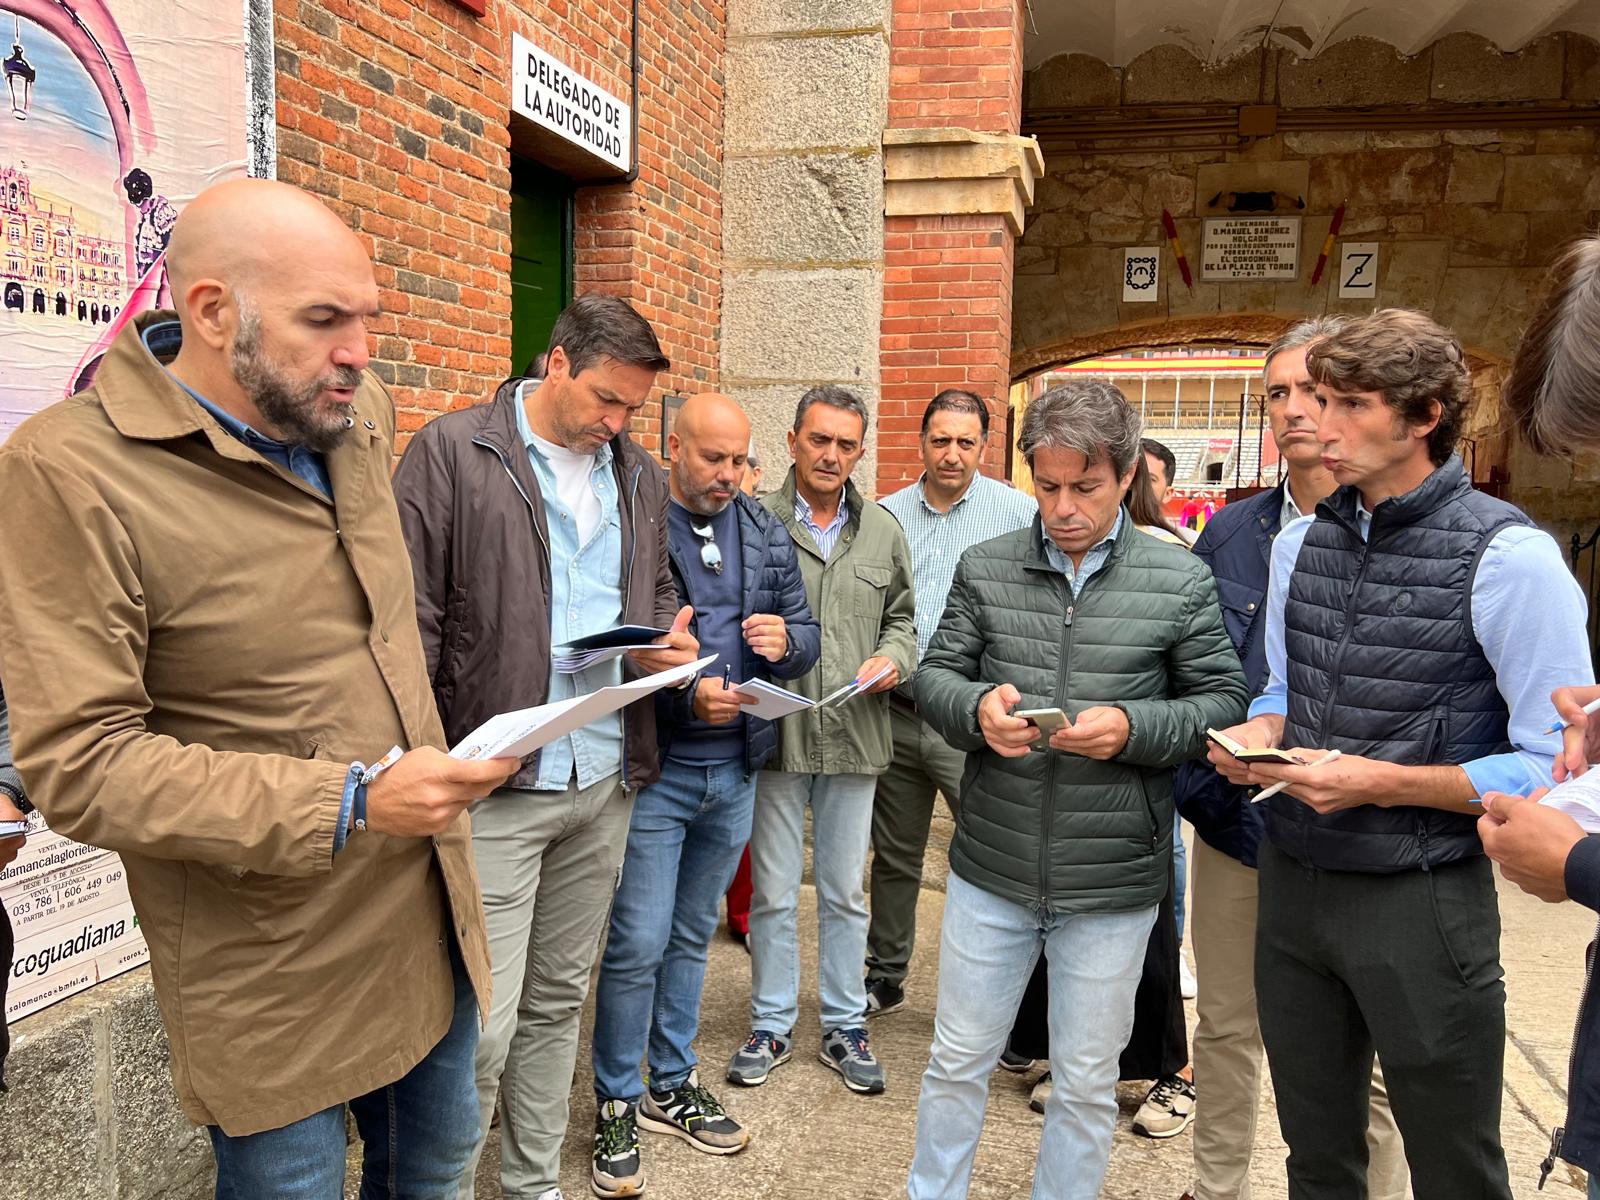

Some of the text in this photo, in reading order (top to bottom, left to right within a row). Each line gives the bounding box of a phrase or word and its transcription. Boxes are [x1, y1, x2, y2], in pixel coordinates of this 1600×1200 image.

[527, 52, 620, 130] DELEGADO DE
[525, 83, 621, 158] LA AUTORIDAD
[1205, 263, 1294, 271] DE LA PLAZA DE TOROS
[38, 839, 74, 854] VENTA ONLI
[12, 871, 122, 917] 033 786 606 449 049
[23, 879, 42, 891] DESDE
[60, 869, 68, 878] DE
[30, 876, 86, 899] VENTA TELEFÓNICA
[23, 911, 44, 924] PARTIR
[46, 906, 57, 916] DEL
[67, 898, 75, 908] DE
[77, 891, 100, 905] AGOSTO
